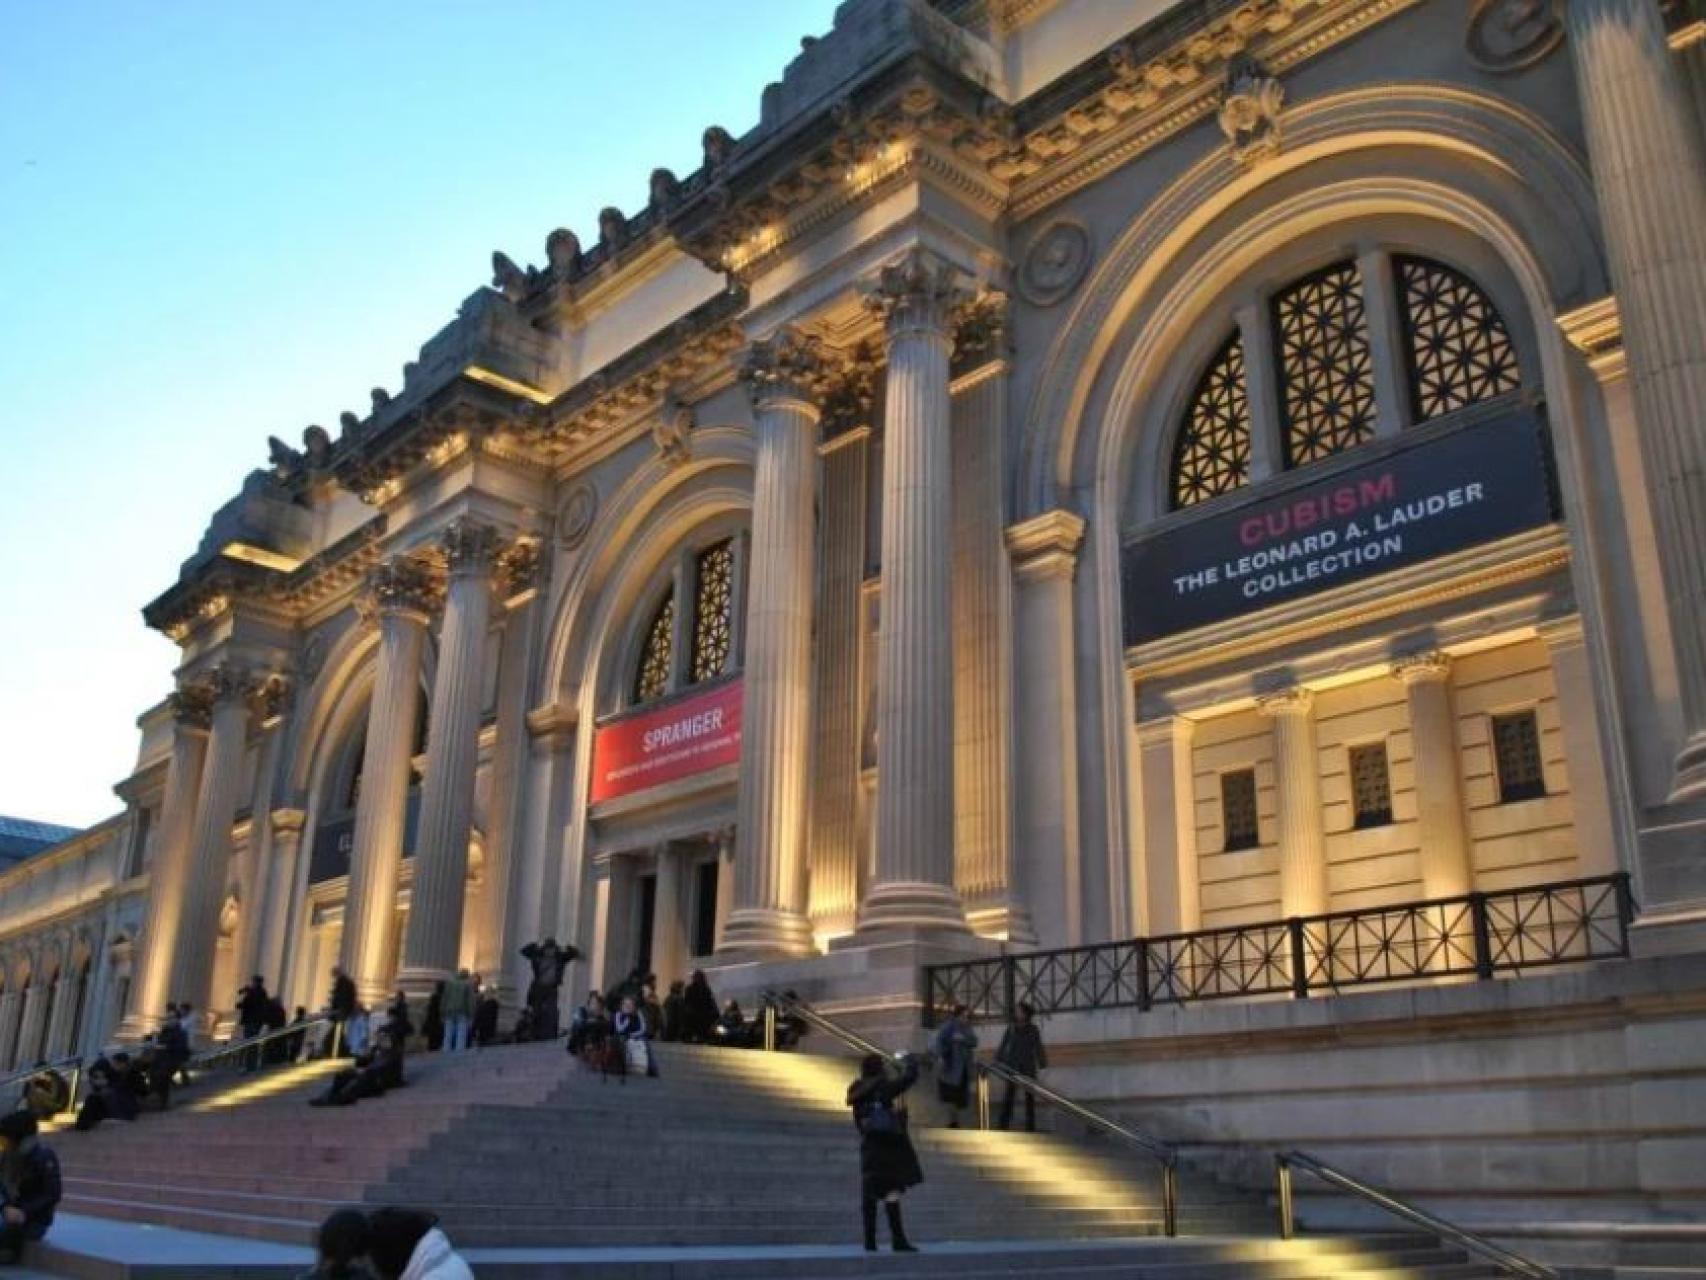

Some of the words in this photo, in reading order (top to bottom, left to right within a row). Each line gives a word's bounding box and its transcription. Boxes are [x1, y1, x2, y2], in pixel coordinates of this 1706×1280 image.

[1174, 568, 1219, 594] THE
[1225, 530, 1337, 578] LEONARD
[1345, 520, 1369, 541] A.
[1375, 482, 1484, 531] LAUDER
[1240, 474, 1396, 546] CUBISM
[1242, 535, 1401, 598] COLLECTION
[643, 709, 723, 752] SPRANGER
